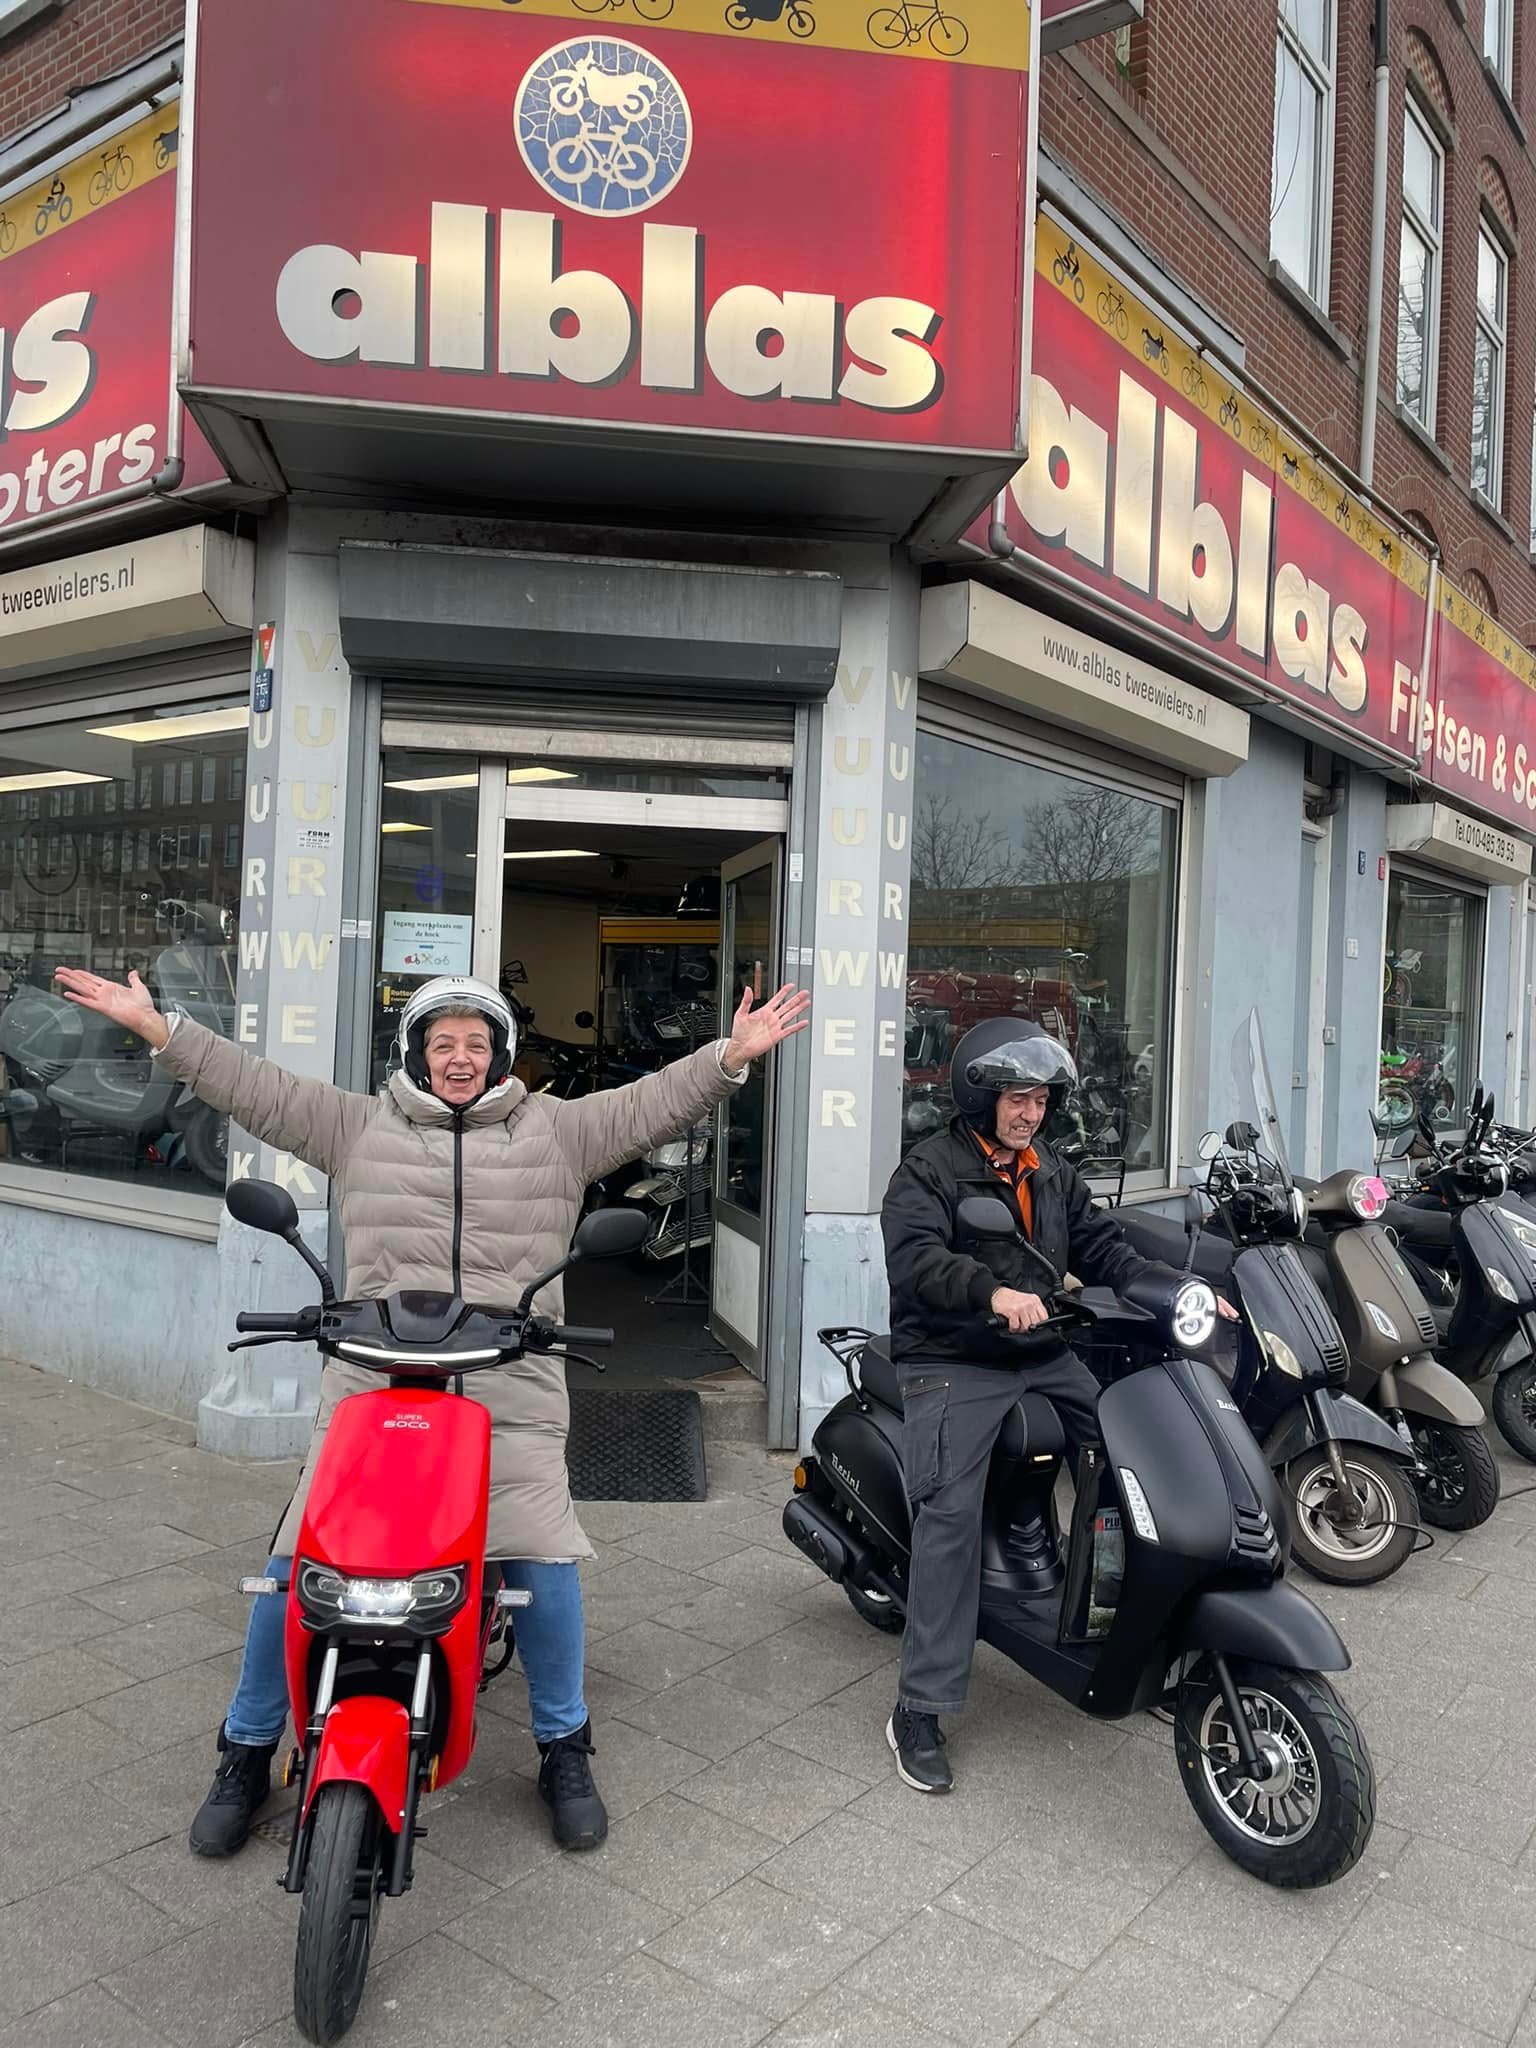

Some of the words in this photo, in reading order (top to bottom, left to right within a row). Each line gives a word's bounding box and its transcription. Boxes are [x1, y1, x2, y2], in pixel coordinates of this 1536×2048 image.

[0, 291, 94, 432] s
[276, 201, 938, 410] alblas
[2, 557, 135, 615] tweewielers.nl
[1010, 370, 1368, 711] alblas
[1043, 636, 1121, 687] www.alblas
[1125, 672, 1207, 727] tweewielers.nl
[1390, 660, 1486, 782] Fietsen
[1492, 734, 1507, 793] &
[383, 1421, 430, 1429] SOCO
